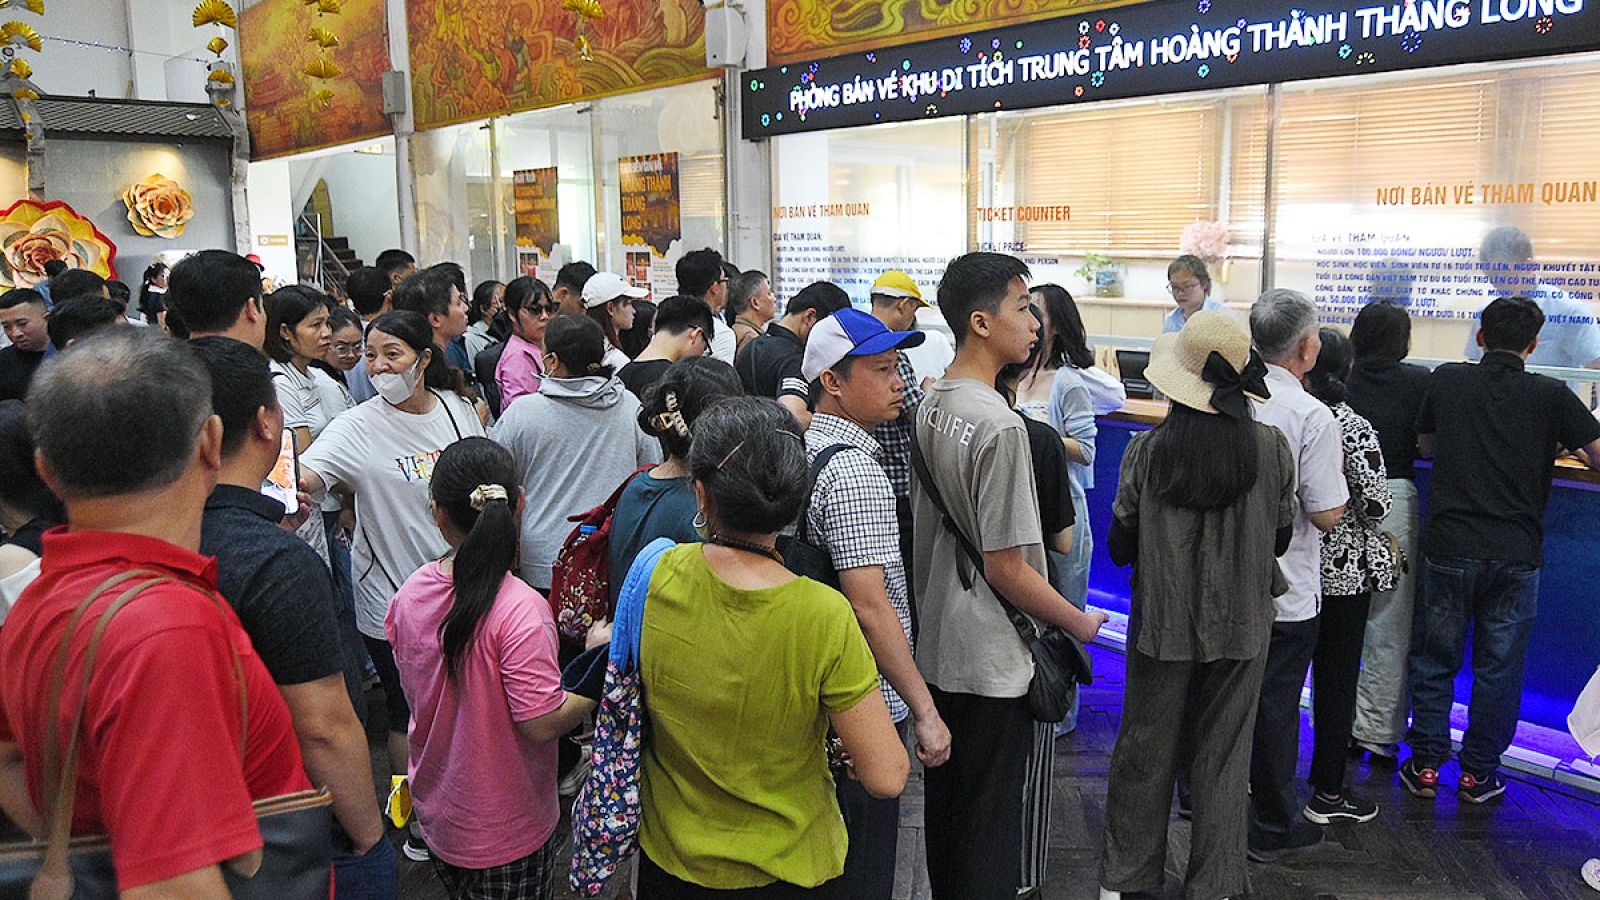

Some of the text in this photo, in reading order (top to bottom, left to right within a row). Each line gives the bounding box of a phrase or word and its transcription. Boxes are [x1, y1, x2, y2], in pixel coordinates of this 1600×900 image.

[790, 82, 840, 112] PHÒNG
[843, 74, 875, 106] BÁN
[877, 69, 898, 100] VÉ
[902, 70, 937, 97] KHU
[942, 67, 963, 92] DI
[967, 56, 1014, 89] TÍCH
[1017, 49, 1089, 82] TRUNG
[1095, 36, 1144, 73] TÂM
[1151, 24, 1241, 65] HOÀNG
[1247, 9, 1348, 53] THÀNH
[1377, 181, 1597, 206] NƠI BÁN VÉ THAM QUAN
[820, 203, 844, 217] THAM
[845, 203, 870, 217] QUAN
[976, 205, 1070, 222] TICKET COUNTER
[1567, 278, 1586, 287] CAO
